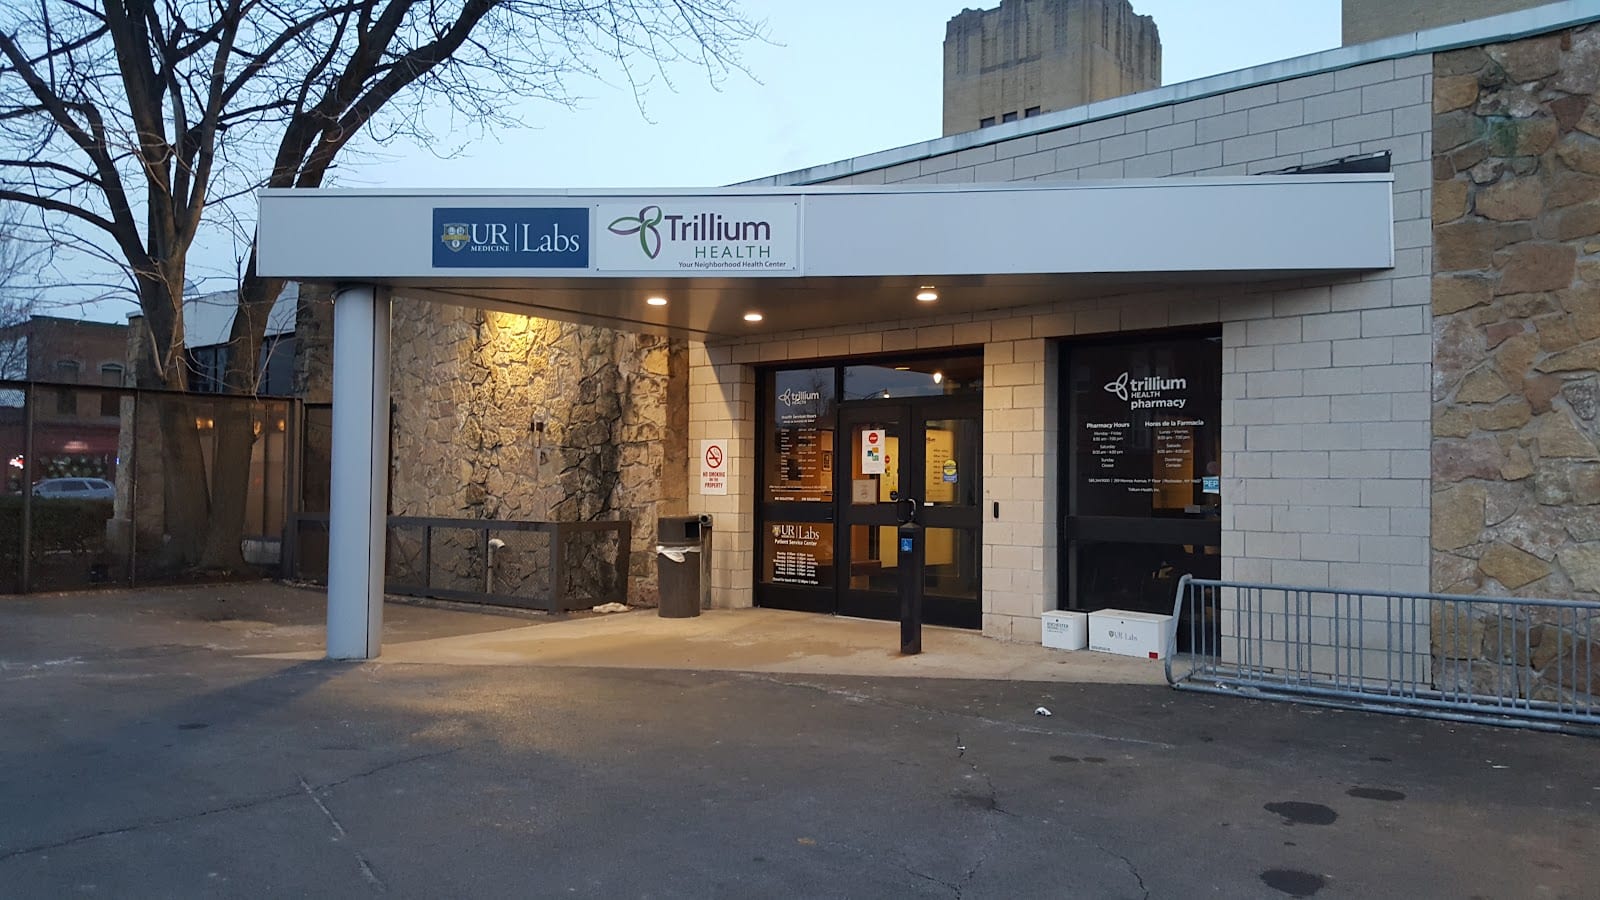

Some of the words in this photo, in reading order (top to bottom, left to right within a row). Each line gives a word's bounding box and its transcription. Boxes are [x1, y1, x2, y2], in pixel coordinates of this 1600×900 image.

[664, 213, 770, 240] Trillium
[471, 223, 509, 244] UR
[521, 223, 579, 252] Labs
[695, 245, 770, 258] HEALTH
[1130, 376, 1186, 391] trillium
[791, 391, 819, 400] trillium
[1130, 399, 1186, 410] pharmacy
[781, 524, 794, 534] UR
[798, 525, 819, 539] Labs
